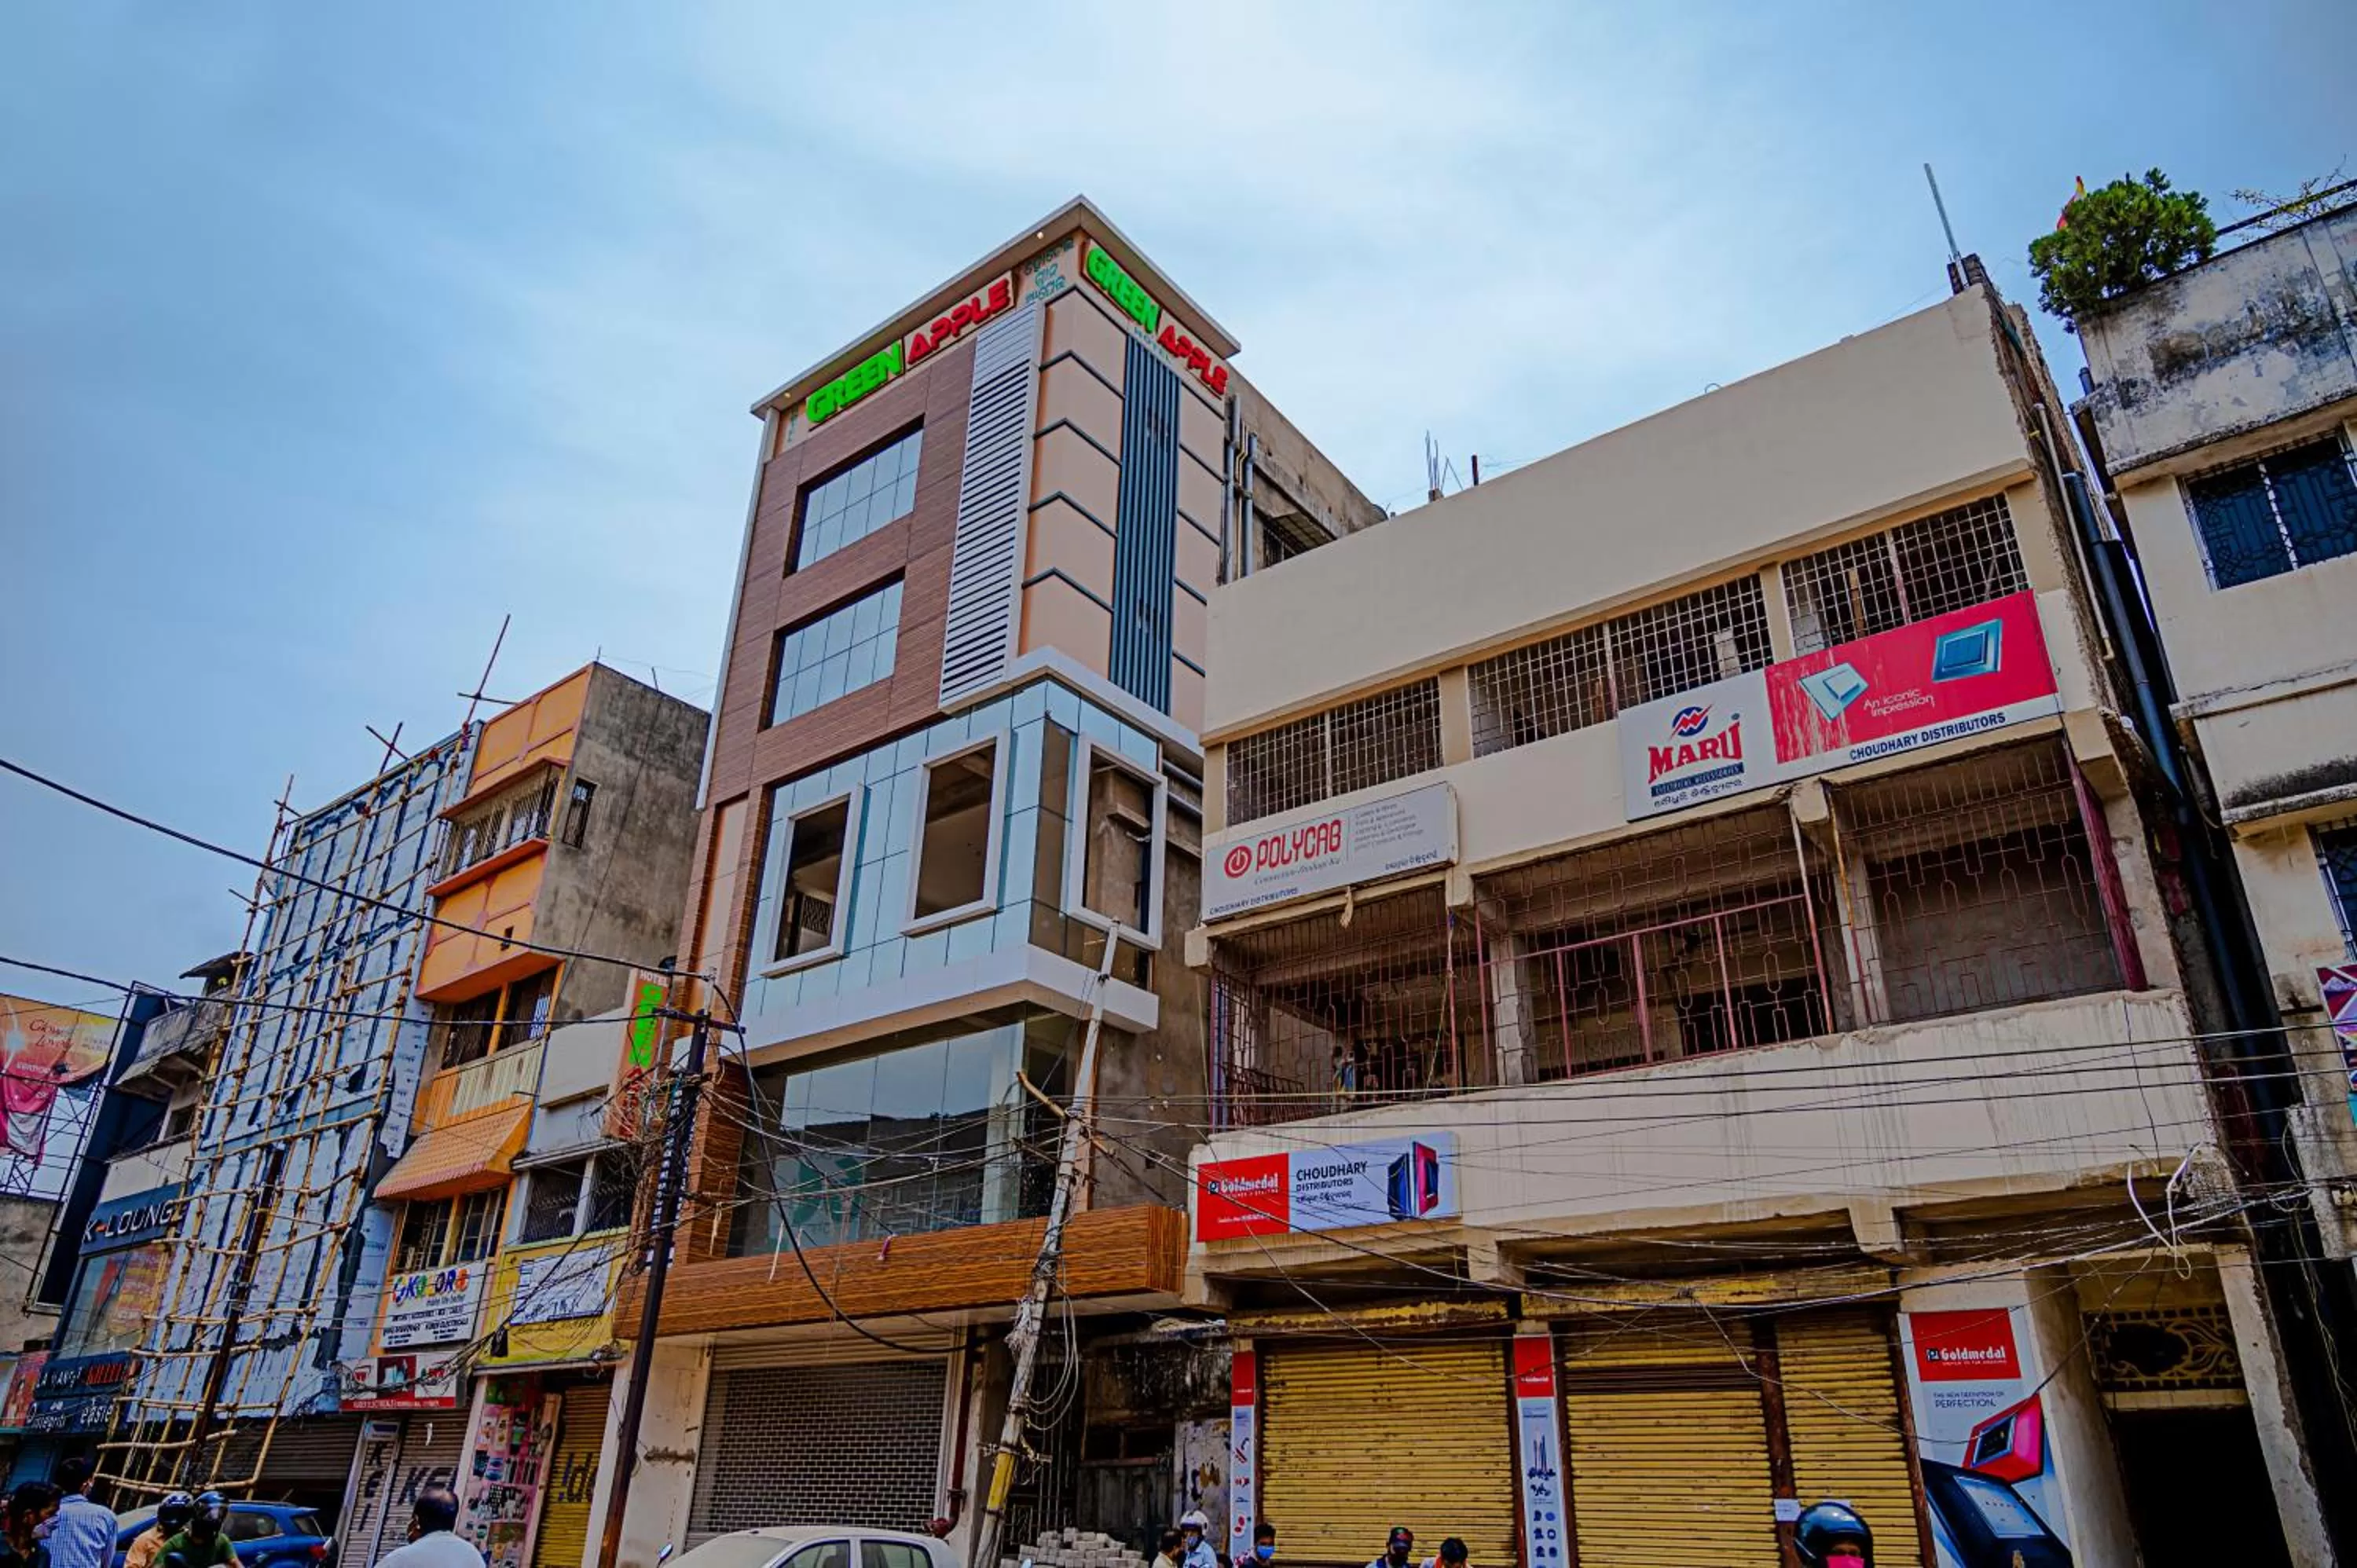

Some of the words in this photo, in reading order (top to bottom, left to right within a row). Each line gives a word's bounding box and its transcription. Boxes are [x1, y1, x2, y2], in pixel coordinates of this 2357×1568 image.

[1086, 247, 1160, 334] GREEN
[1157, 324, 1228, 395] APPLE
[806, 341, 903, 423] GREEN
[907, 278, 1010, 365] APPLE
[1648, 721, 1743, 785] MARU
[1849, 734, 1919, 760] CHOUDHARY
[1921, 712, 2006, 742] DISTRIBUTORS
[1255, 819, 1342, 872] POLYCAB
[1296, 1160, 1368, 1181] CHOUDHARY
[1296, 1178, 1353, 1192] DISTRIBUTORS
[1941, 1345, 2006, 1361] Goldmedal
